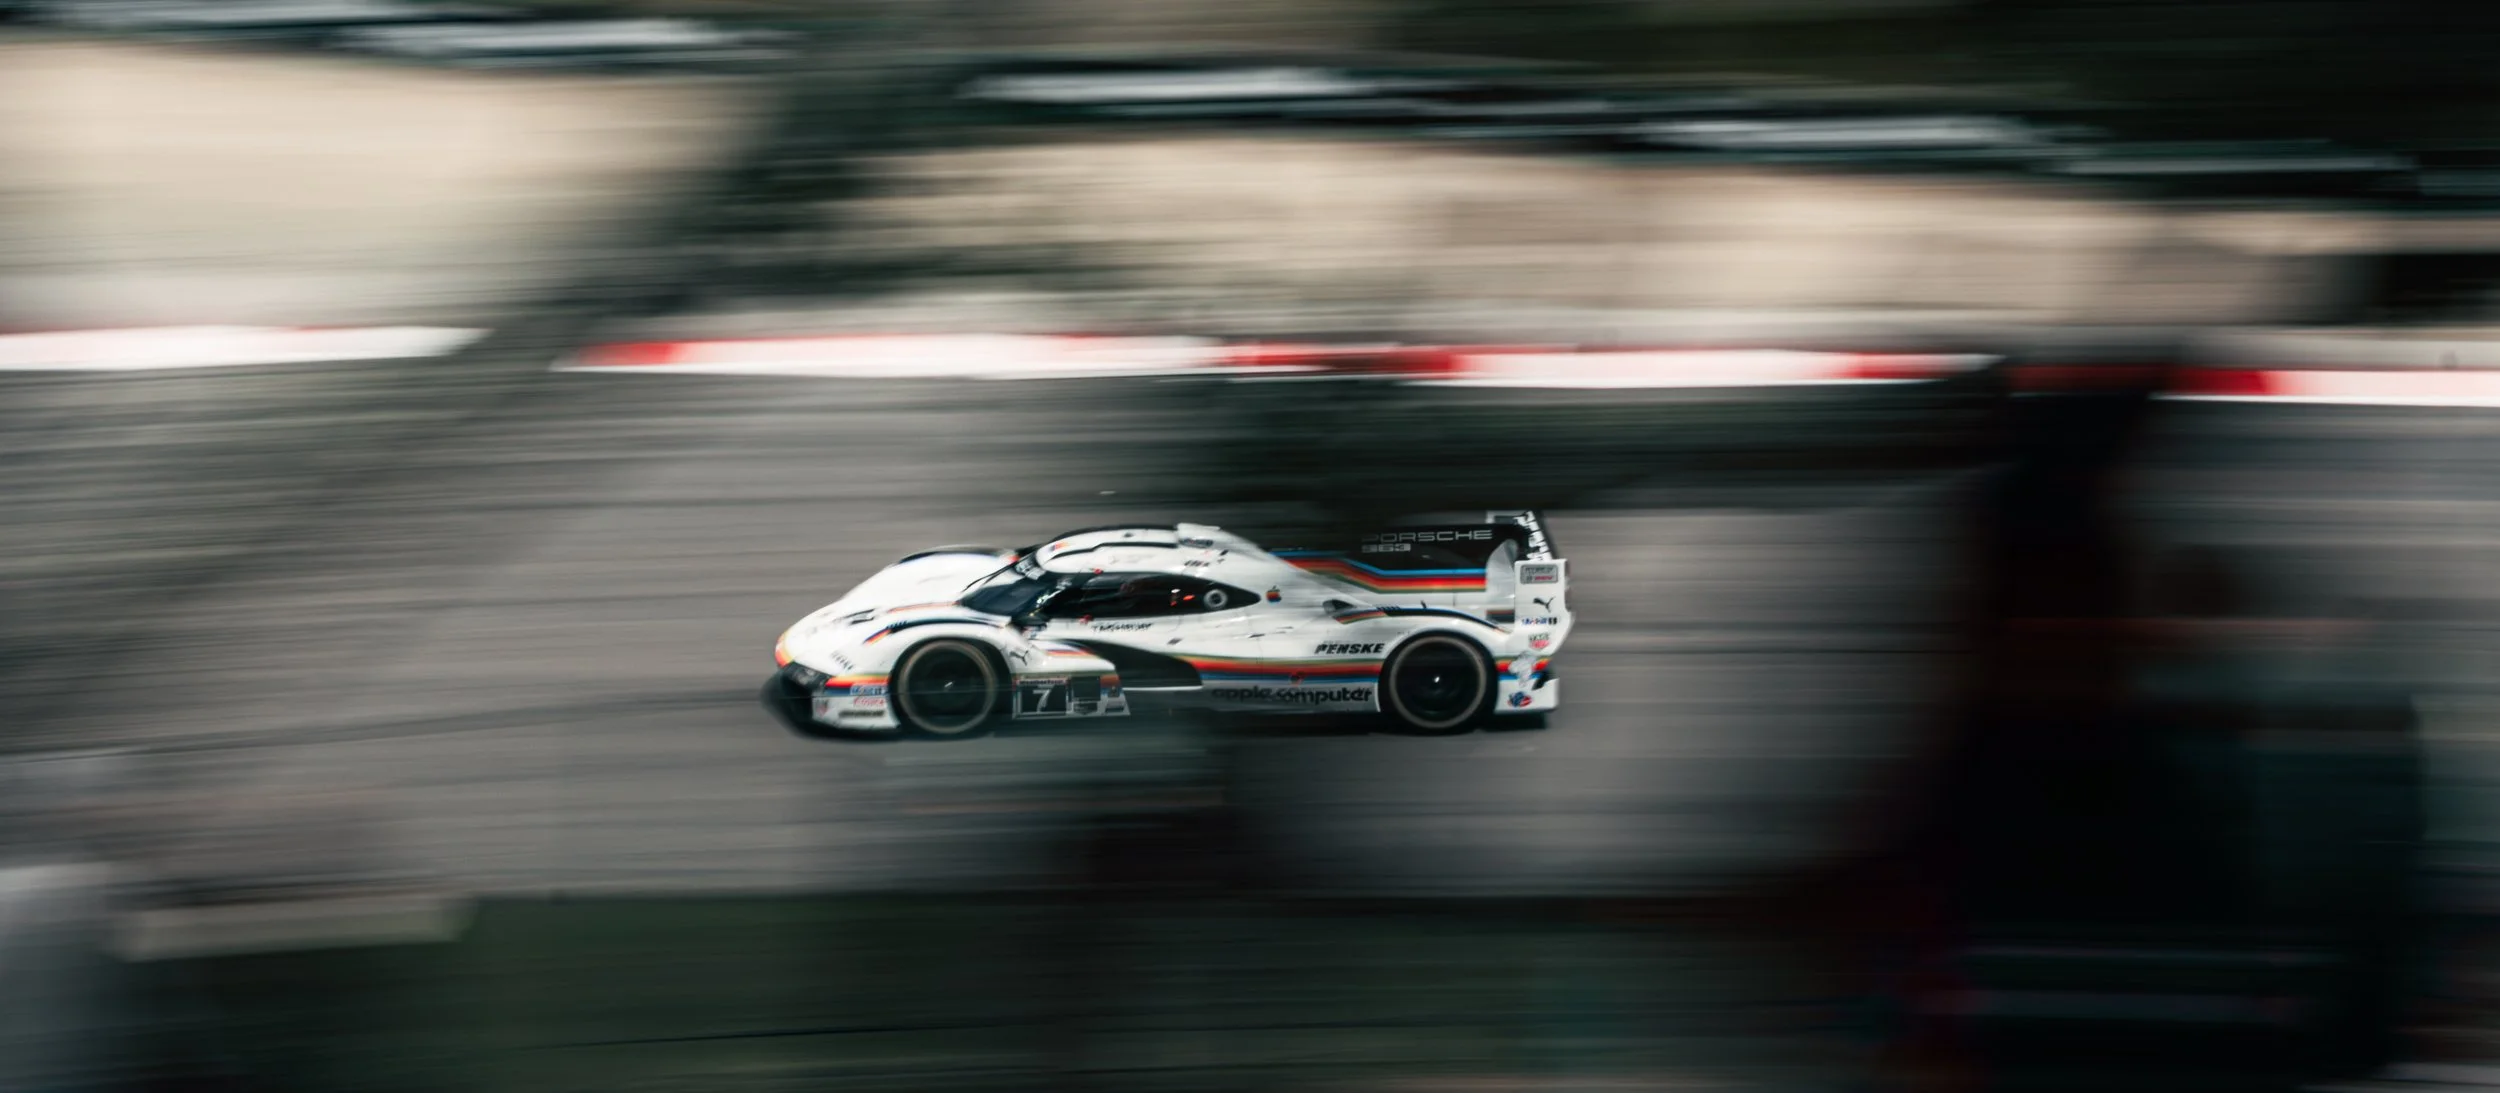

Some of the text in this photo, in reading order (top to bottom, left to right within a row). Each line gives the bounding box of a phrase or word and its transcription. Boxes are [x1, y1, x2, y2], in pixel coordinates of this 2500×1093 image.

[1361, 530, 1493, 543] PORSCHE
[1315, 643, 1385, 654] PENSKE
[1032, 688, 1051, 714] 7
